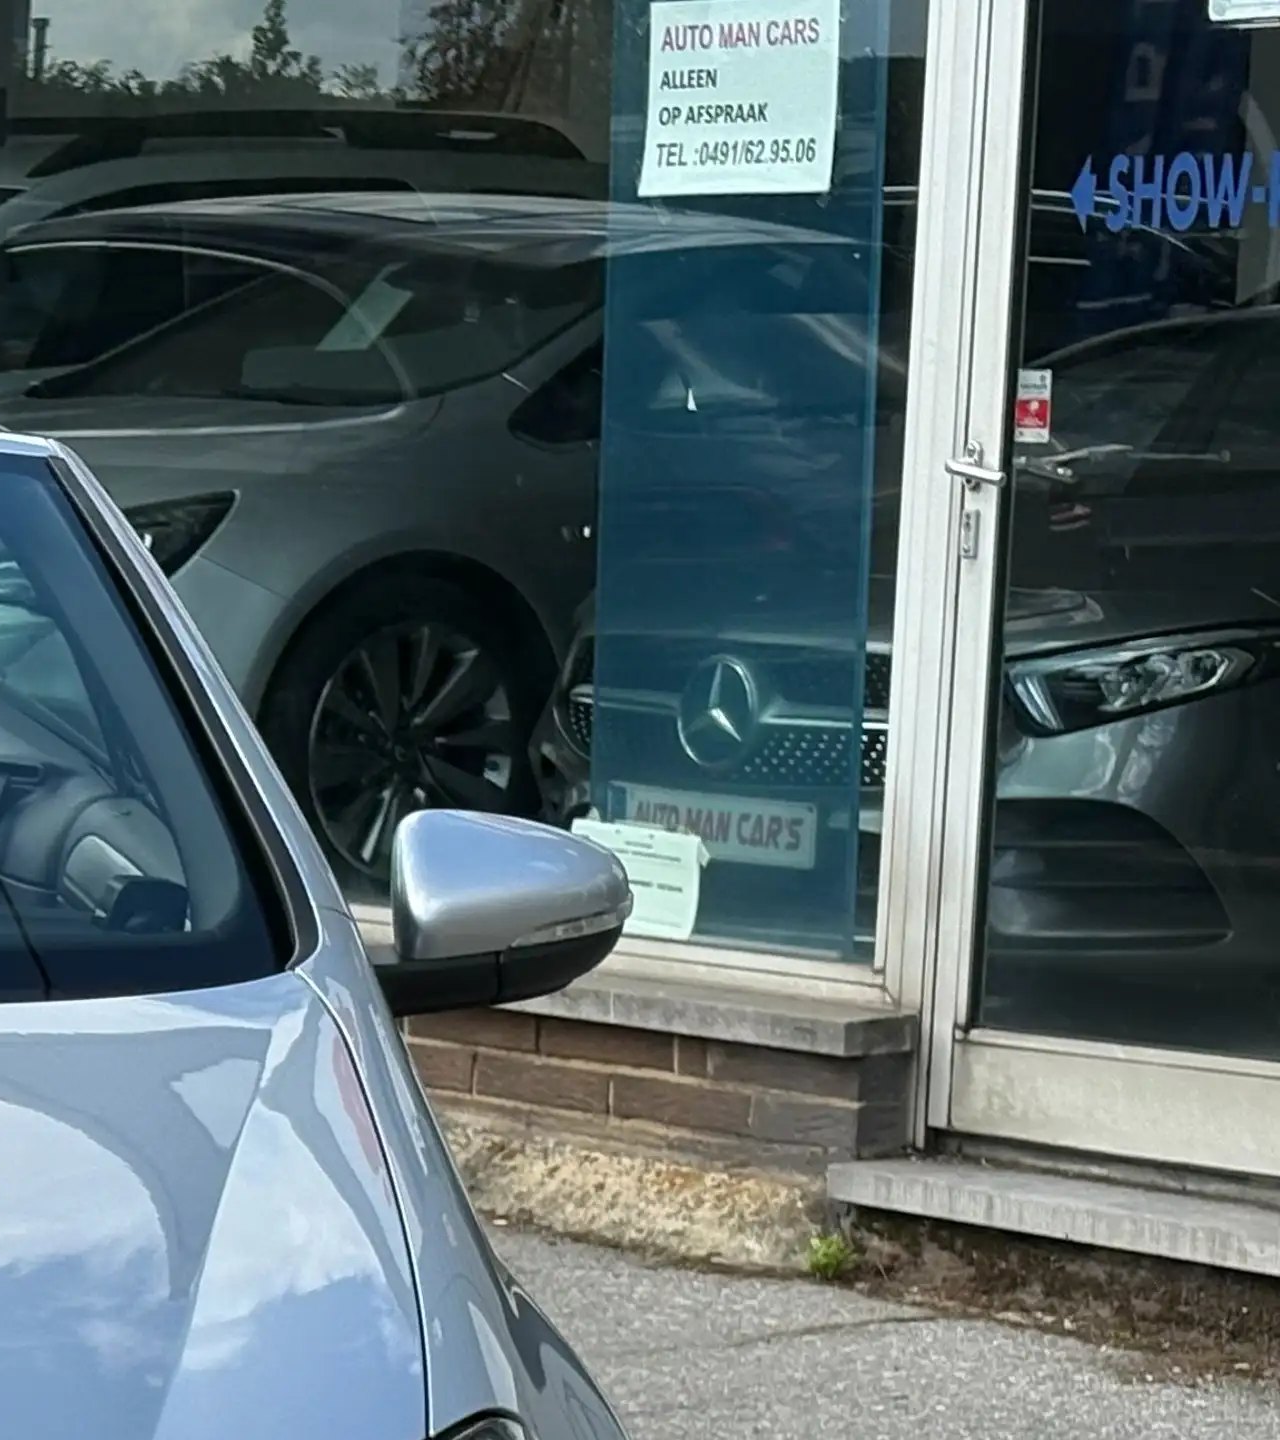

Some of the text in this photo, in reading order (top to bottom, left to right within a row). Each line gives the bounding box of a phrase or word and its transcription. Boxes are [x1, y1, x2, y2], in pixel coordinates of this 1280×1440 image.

[661, 17, 820, 52] AUTO MAN CARS
[659, 68, 718, 90] ALLEEN
[658, 102, 769, 126] OP AFSPRAAK
[656, 142, 688, 167] TEL
[1105, 151, 1280, 233] SHOW-
[684, 806, 732, 844] MAN
[736, 812, 804, 851] CAR'S
